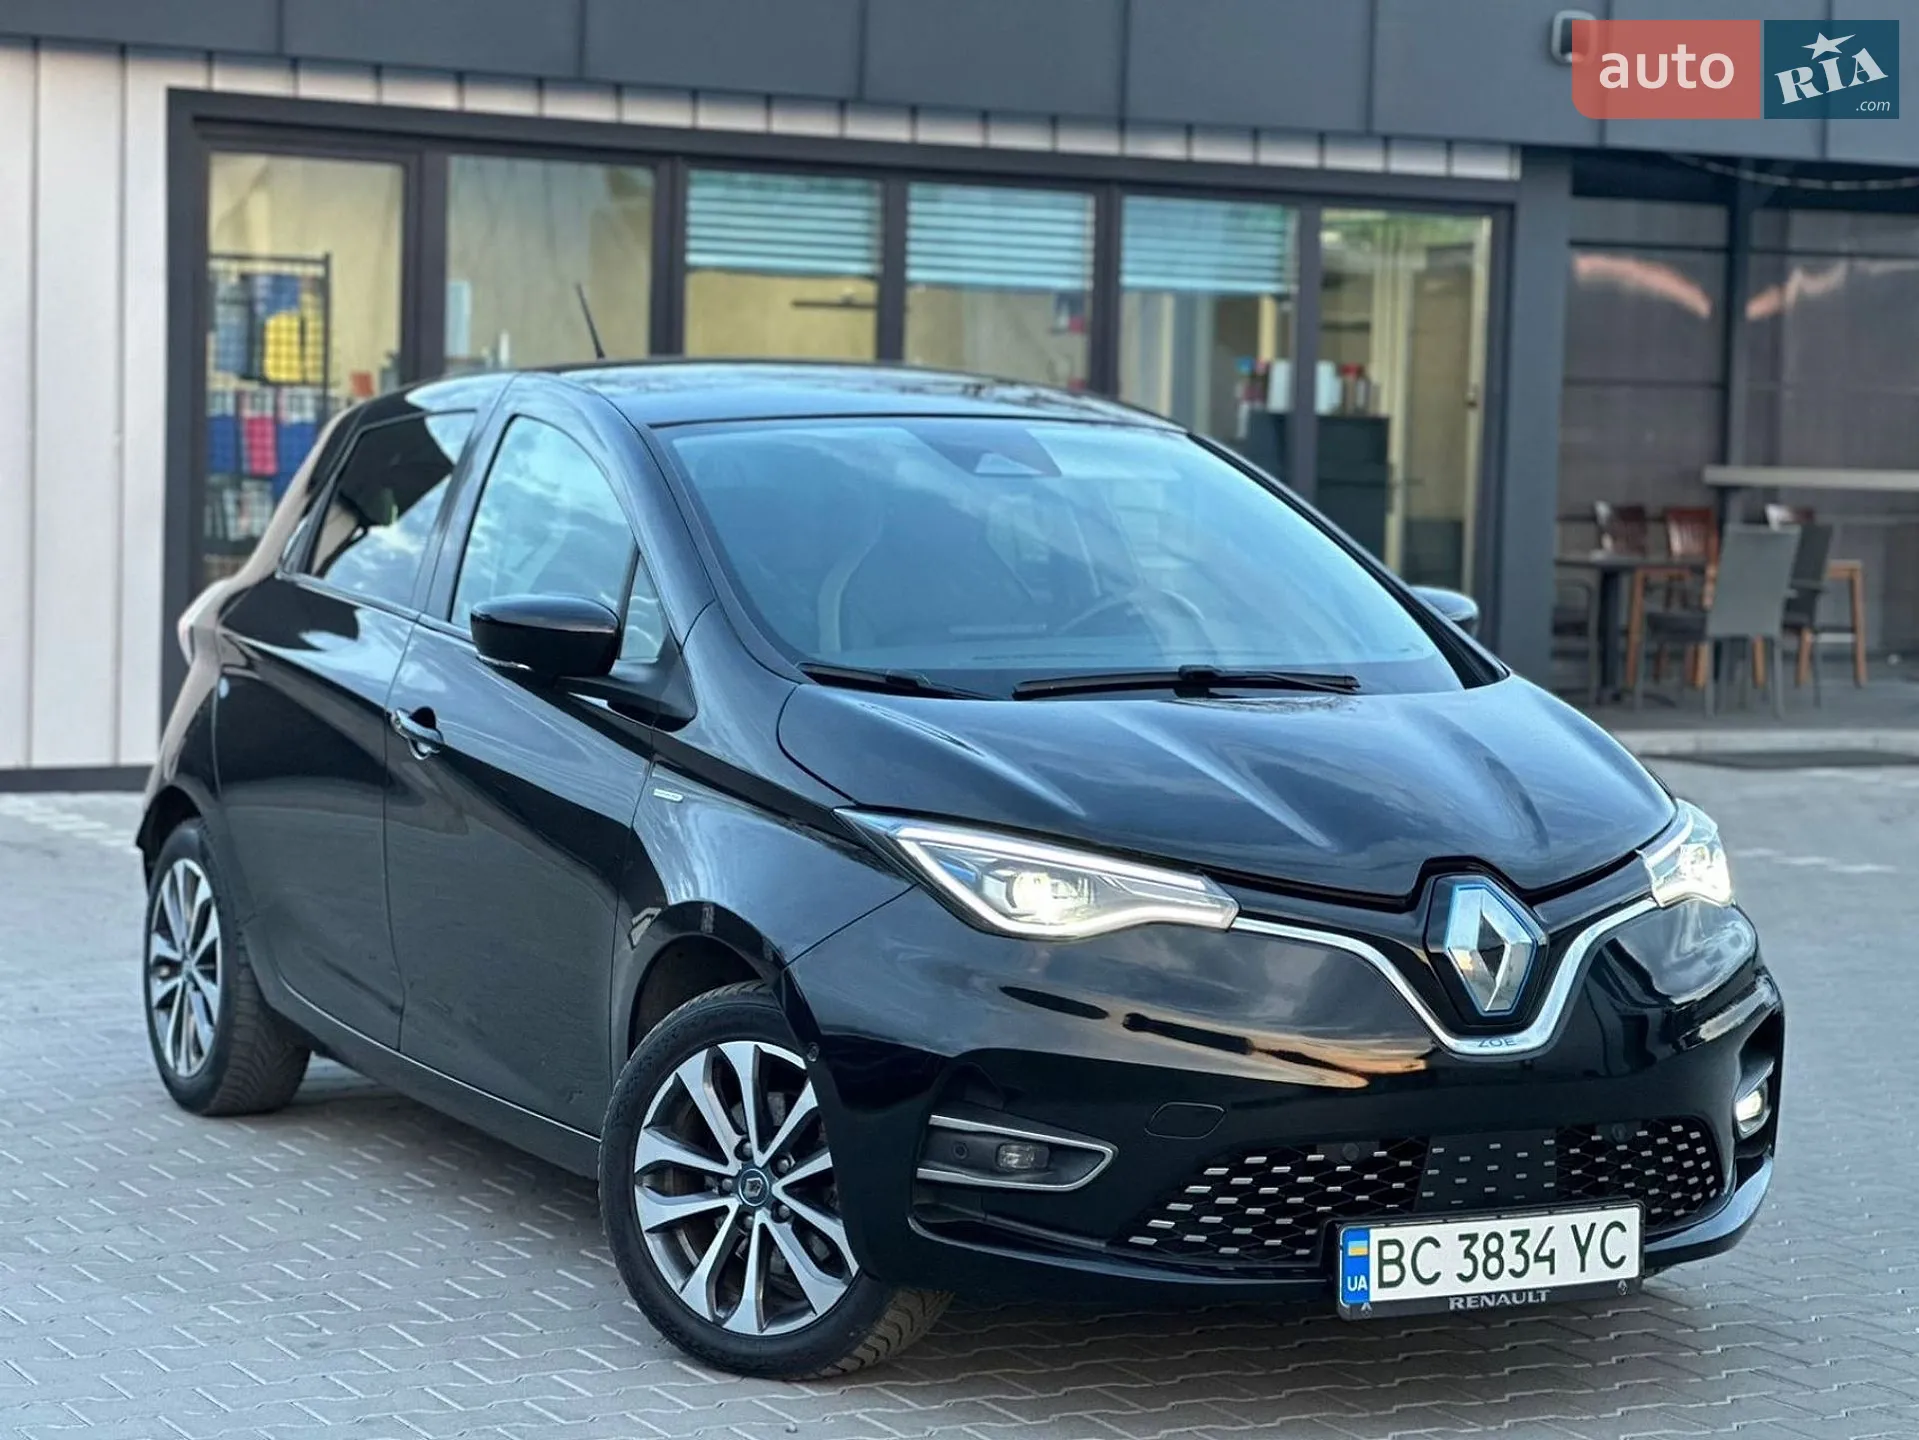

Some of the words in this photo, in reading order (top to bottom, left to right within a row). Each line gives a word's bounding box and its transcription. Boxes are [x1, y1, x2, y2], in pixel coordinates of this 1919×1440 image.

[1478, 1037, 1517, 1048] ZOE
[1377, 1235, 1442, 1289] BC
[1456, 1225, 1556, 1284] 3834
[1570, 1220, 1628, 1273] YC
[1347, 1275, 1368, 1292] UA
[1448, 1288, 1552, 1311] RENAULT
